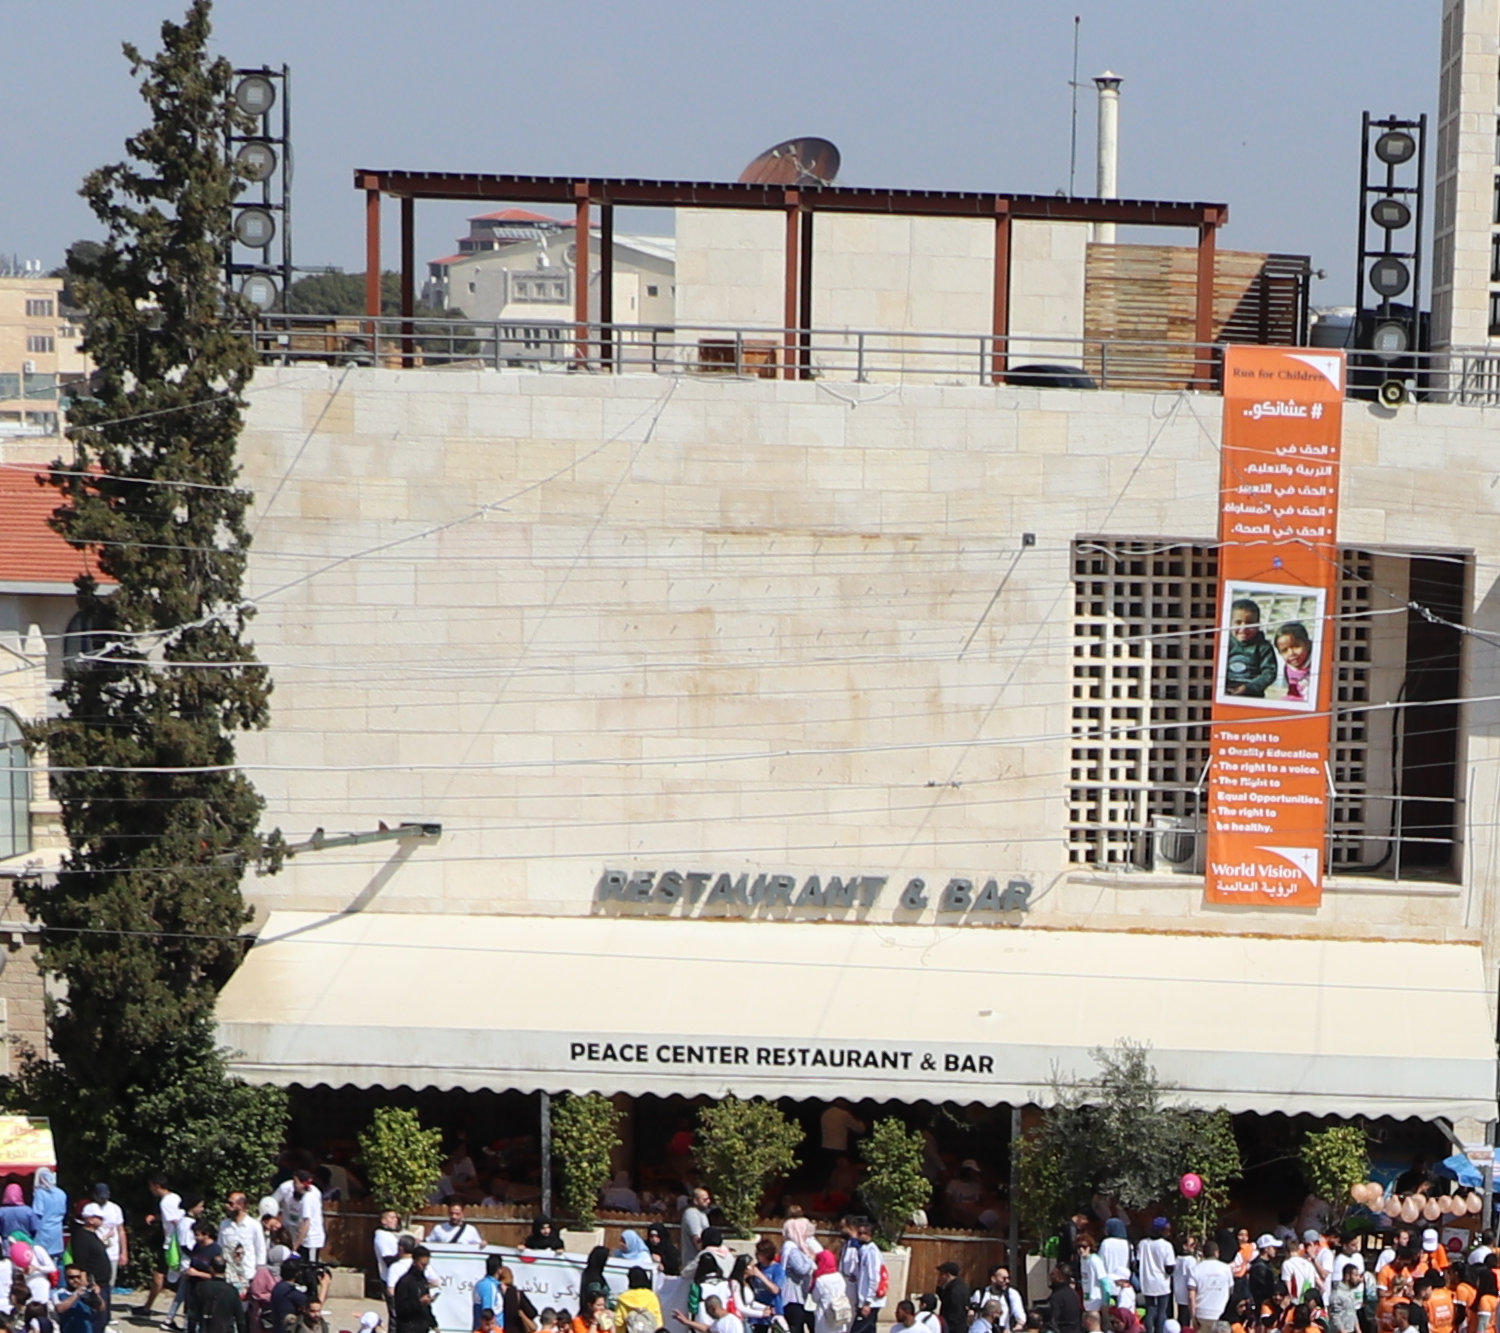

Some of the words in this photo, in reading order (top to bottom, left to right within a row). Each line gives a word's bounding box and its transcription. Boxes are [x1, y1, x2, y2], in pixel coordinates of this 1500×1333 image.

[1219, 731, 1240, 742] The
[1241, 731, 1267, 744] right
[1267, 733, 1280, 743] to
[1266, 748, 1319, 760] Education
[1218, 761, 1239, 772] The
[1240, 762, 1266, 774] right
[1266, 763, 1279, 773] to
[1218, 777, 1238, 787] The
[1267, 778, 1281, 788] to
[1216, 791, 1248, 803] Equal
[1217, 807, 1237, 818] The
[1238, 807, 1264, 820] right
[1264, 809, 1277, 819] to
[1231, 822, 1274, 834] healthy.
[1211, 862, 1255, 877] World
[1257, 863, 1303, 880] Vision
[597, 868, 888, 910] RESTAURANT
[900, 877, 929, 912] &
[938, 877, 1034, 913] BAR
[569, 1041, 649, 1064] PEACE
[655, 1043, 750, 1066] CENTER
[755, 1045, 913, 1071] RESTAURANT
[919, 1052, 937, 1072] &
[943, 1053, 995, 1075] BAR
